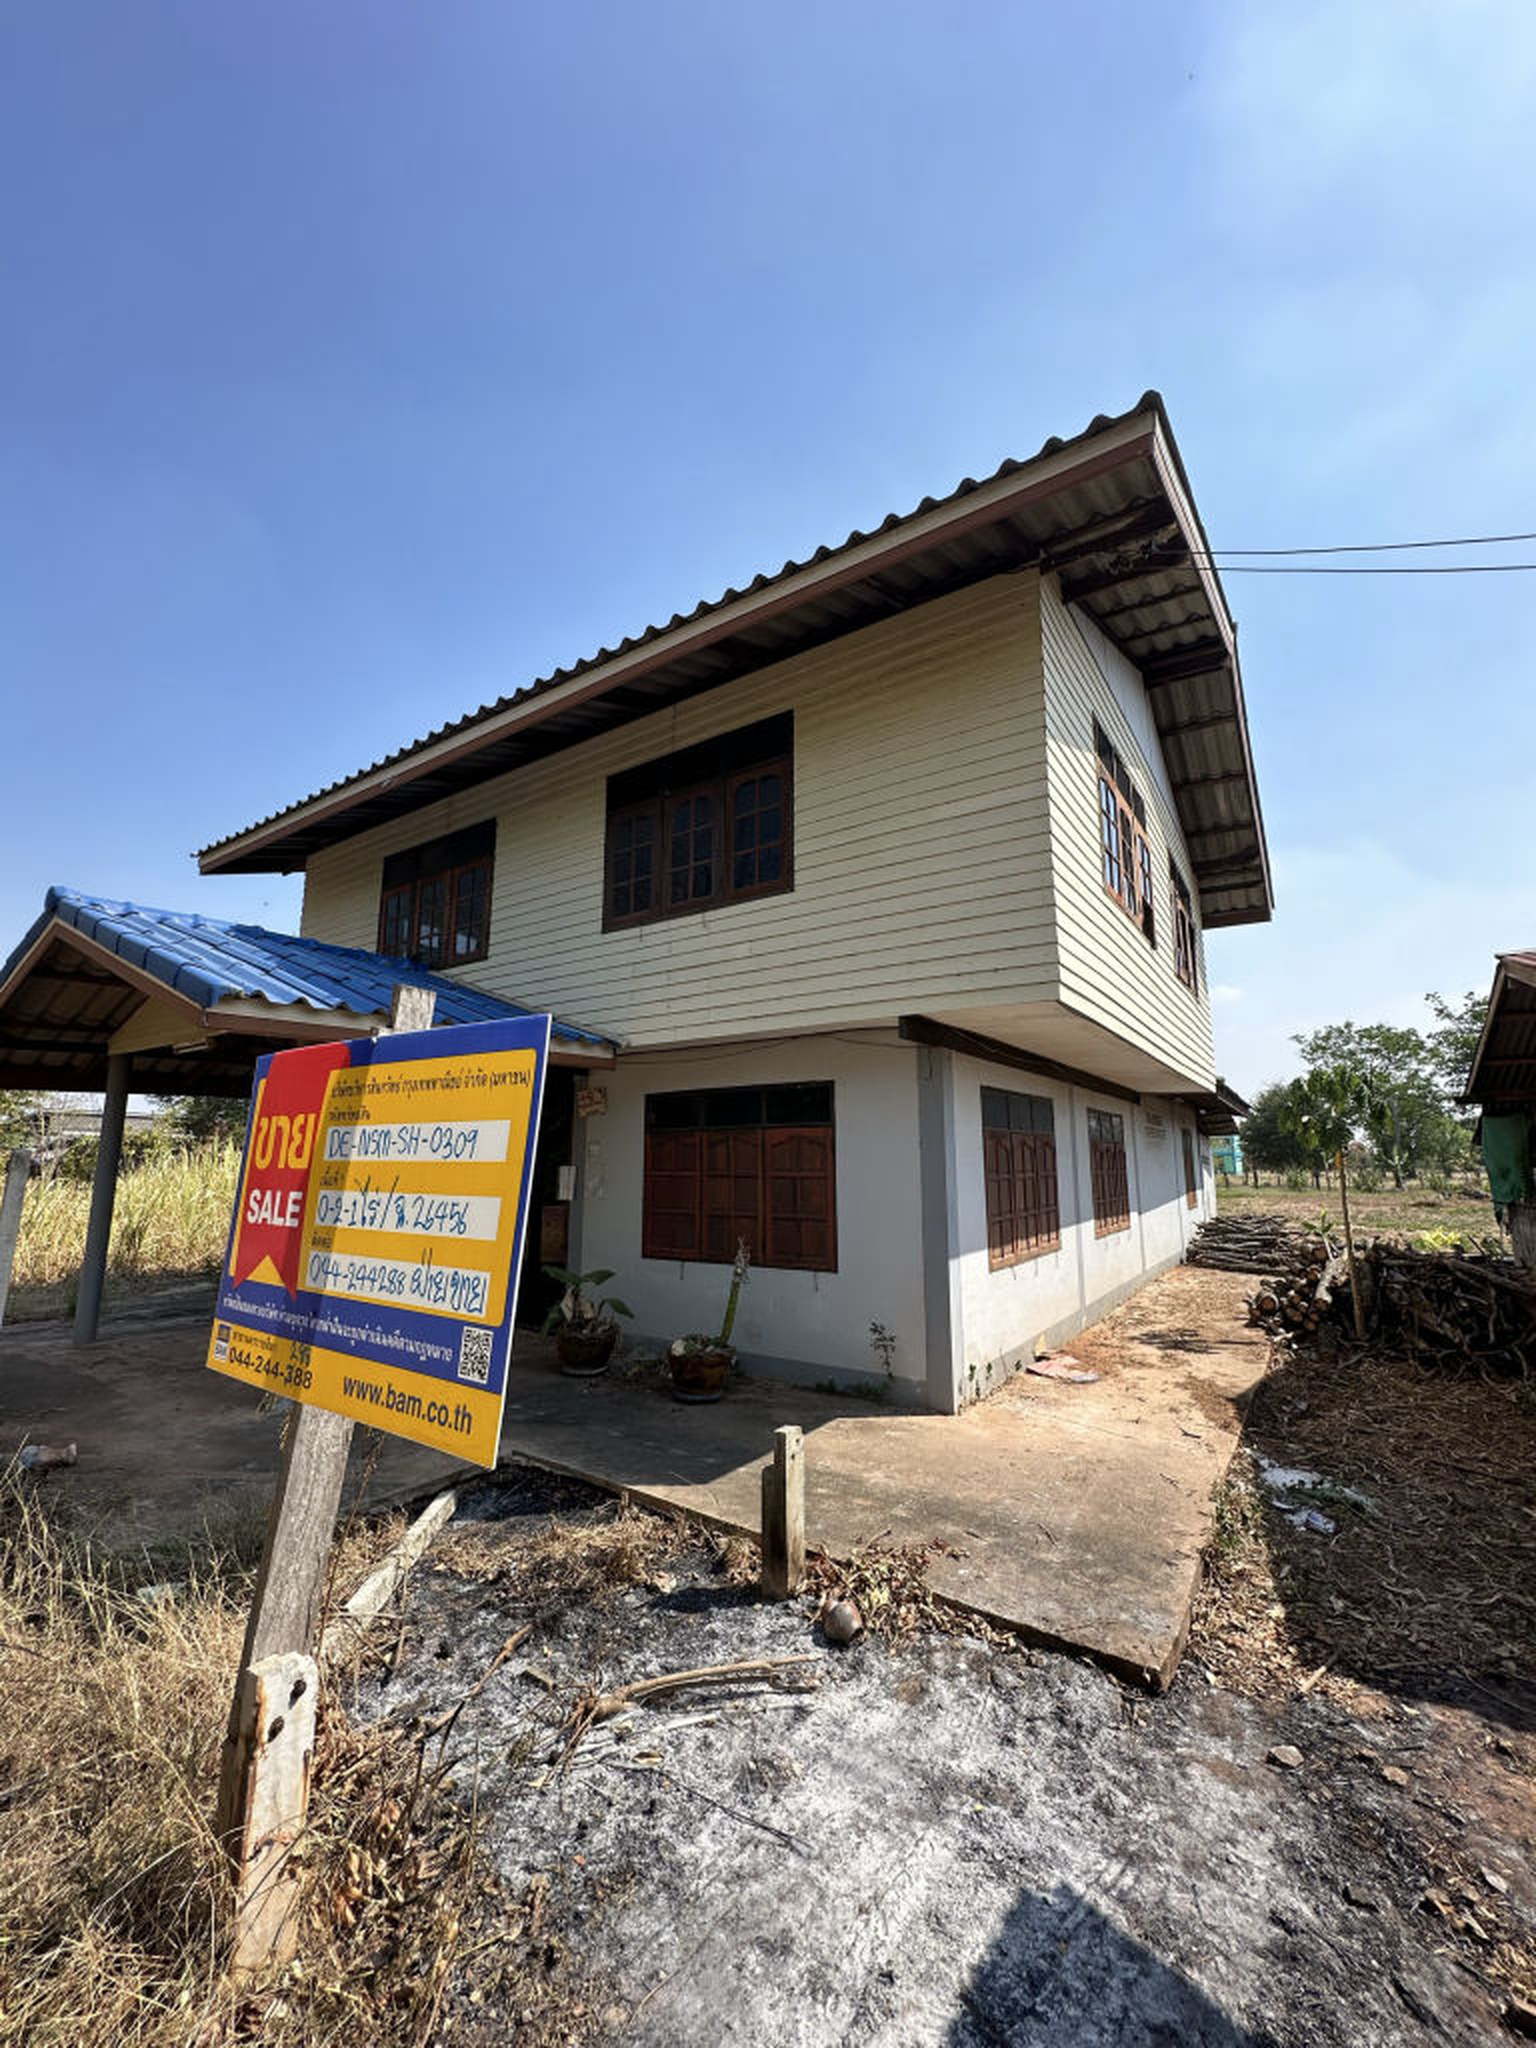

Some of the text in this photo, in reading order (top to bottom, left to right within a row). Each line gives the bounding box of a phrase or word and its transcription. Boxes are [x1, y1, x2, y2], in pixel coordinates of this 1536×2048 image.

[255, 1113, 318, 1169] ขาย
[247, 1188, 303, 1228] SALE
[229, 1346, 313, 1389] 044-244-388
[343, 1375, 473, 1435] www.bam.co.th
